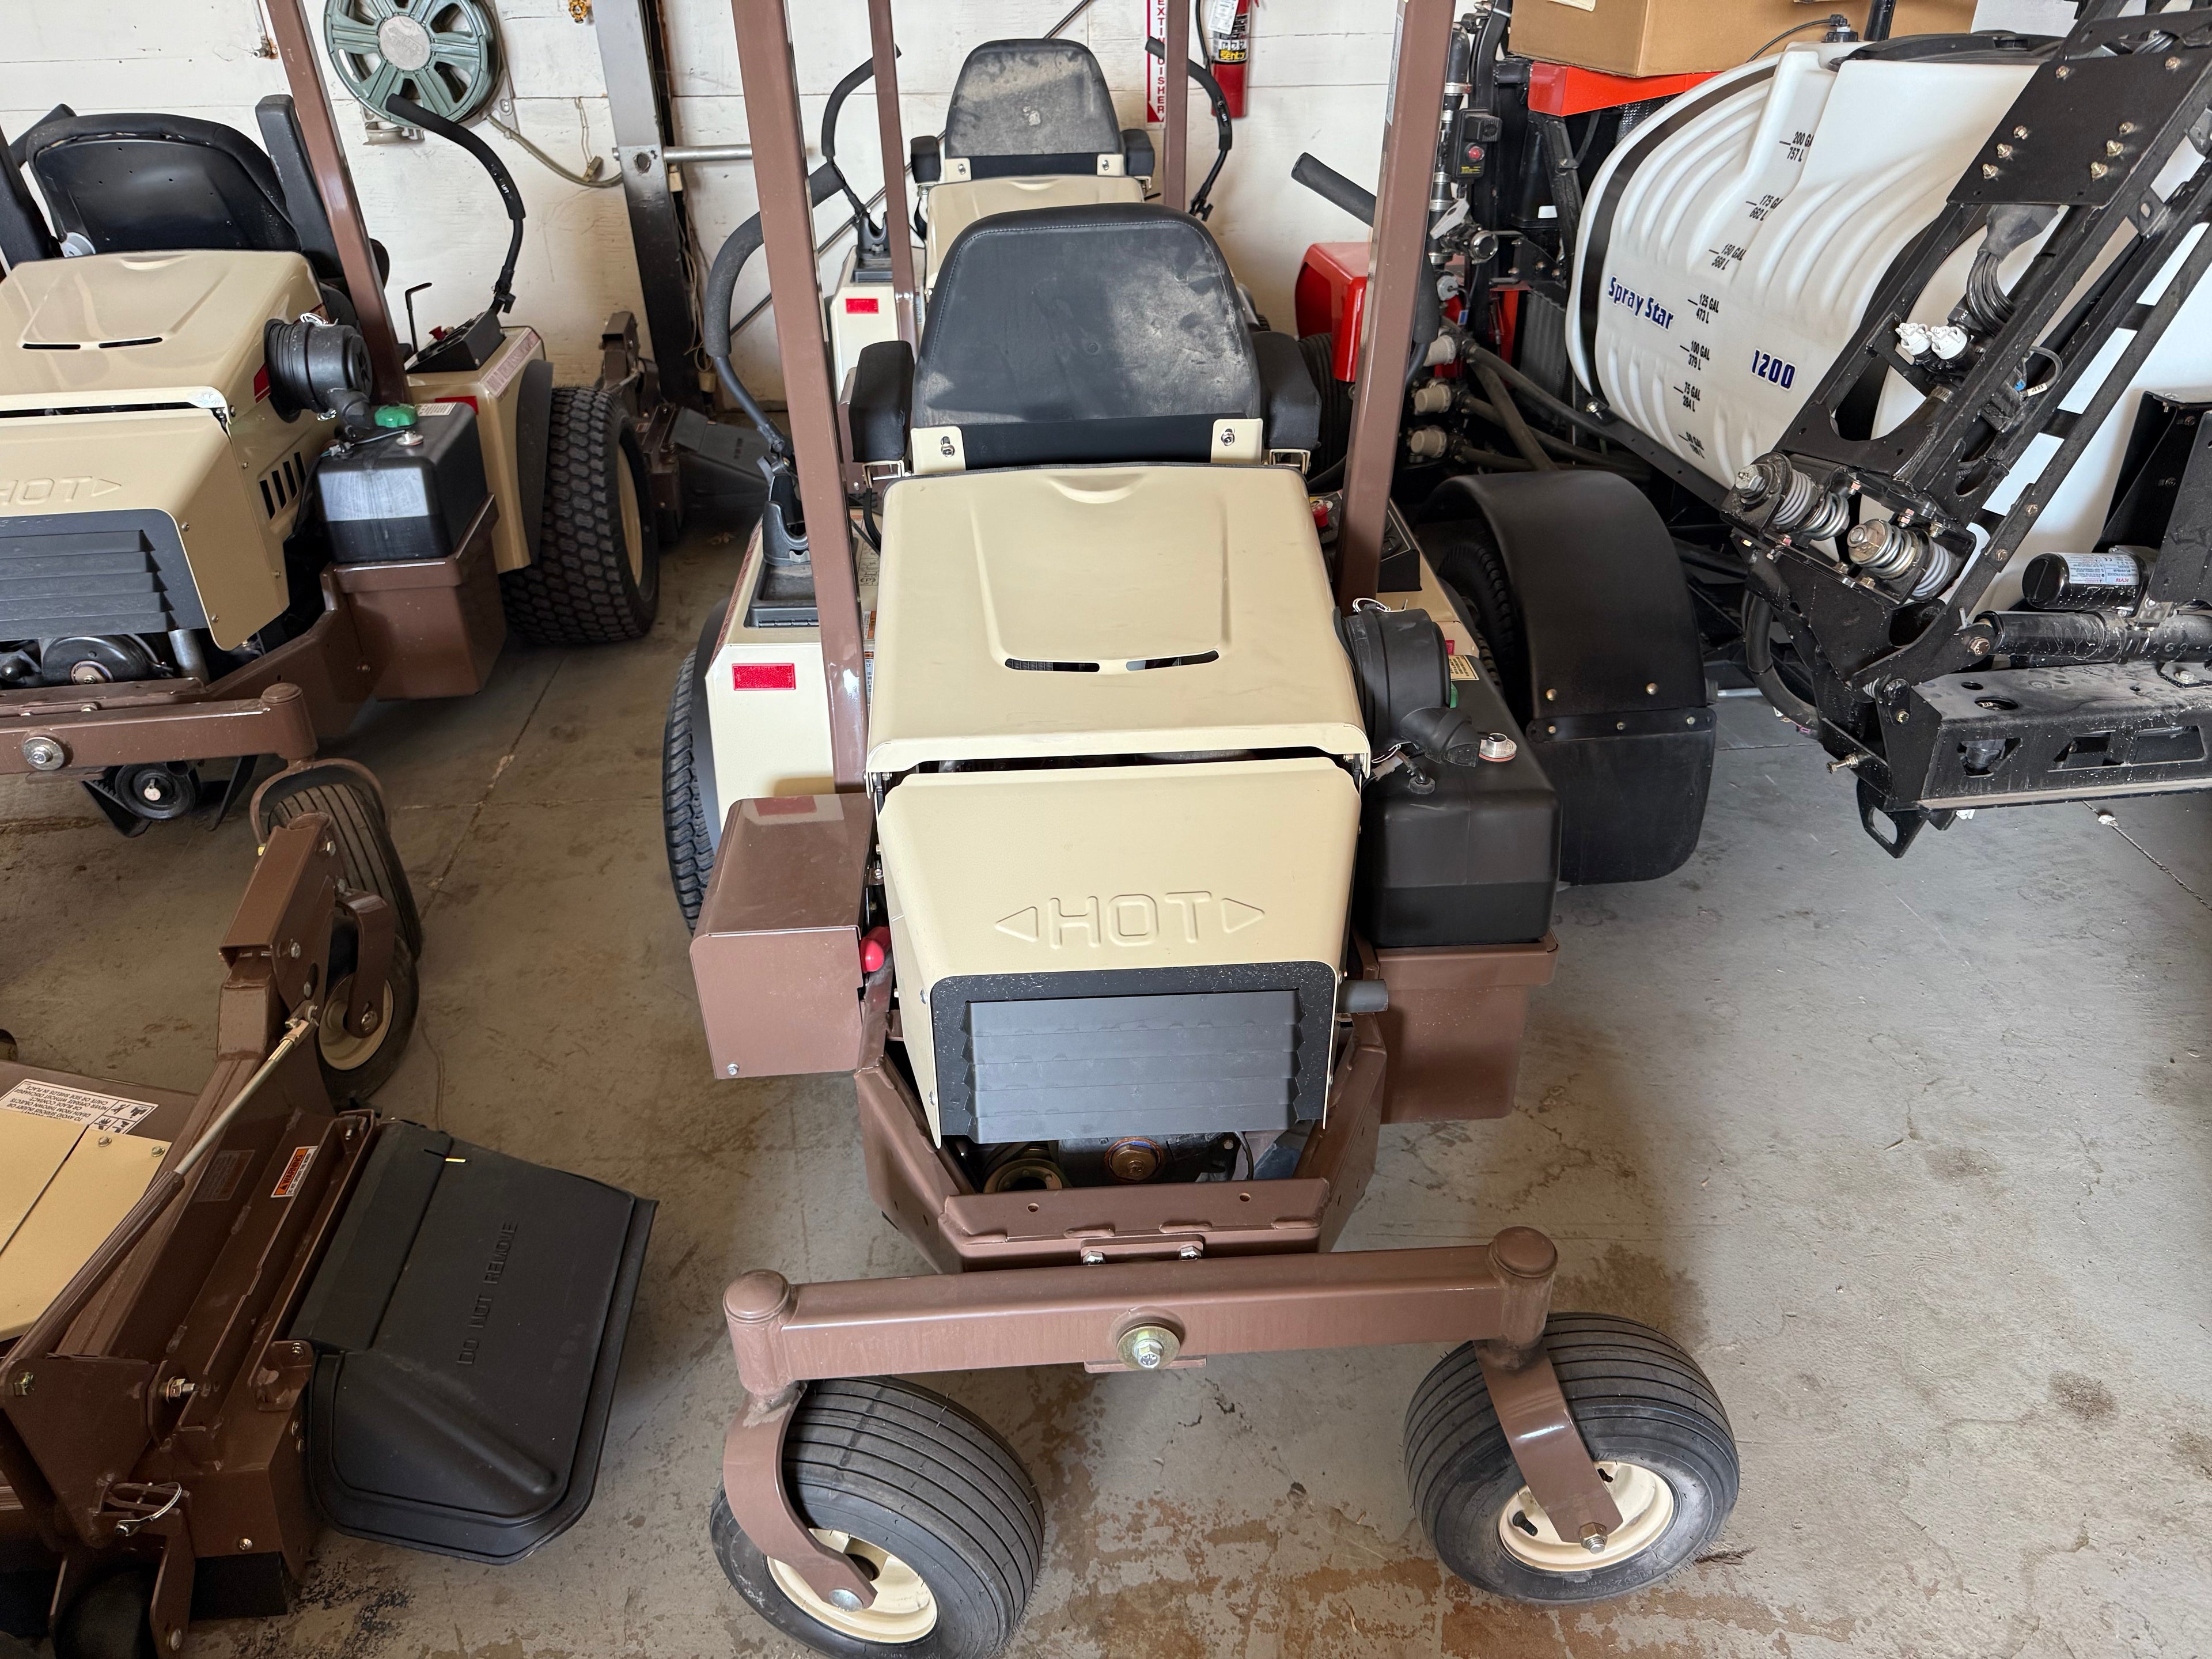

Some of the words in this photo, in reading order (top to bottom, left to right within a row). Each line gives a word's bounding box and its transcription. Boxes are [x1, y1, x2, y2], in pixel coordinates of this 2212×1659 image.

[1157, 0, 1165, 113] EXTIUISHER
[1792, 131, 1805, 146] 200
[1787, 146, 1801, 161] 757
[1798, 149, 1804, 162] L
[1759, 194, 1774, 207] 175
[1749, 207, 1764, 219] 662
[1759, 210, 1768, 221] L
[1721, 243, 1735, 256] 150
[1731, 247, 1747, 261] GAL
[1711, 256, 1726, 268] 568
[1721, 259, 1730, 270] L
[1608, 276, 1645, 317] Spray
[1645, 297, 1674, 330] Star
[1699, 293, 1709, 308] 125
[1709, 298, 1719, 313] GAL
[1696, 308, 1706, 322] 473
[1705, 312, 1709, 324] L
[1691, 340, 1700, 355] 100
[1700, 346, 1710, 361] GAL
[1688, 354, 1698, 368] 379
[1698, 358, 1701, 370] L
[1751, 349, 1796, 389] 1200
[1684, 381, 1691, 395] 75
[1691, 386, 1700, 402] GAL
[1692, 401, 1695, 412] L
[1693, 436, 1704, 451] GAL
[1048, 891, 1212, 950] HOT
[13, 1088, 45, 1097] DISCHARGE
[44, 1094, 67, 1103] WITHOUT
[33, 1103, 57, 1111] THROWN
[67, 1099, 91, 1107] OPERATE
[281, 1154, 304, 1184] WARNING
[456, 1339, 479, 1364] DO
[469, 1294, 492, 1328] NOT
[483, 1222, 518, 1284] REMOVE
